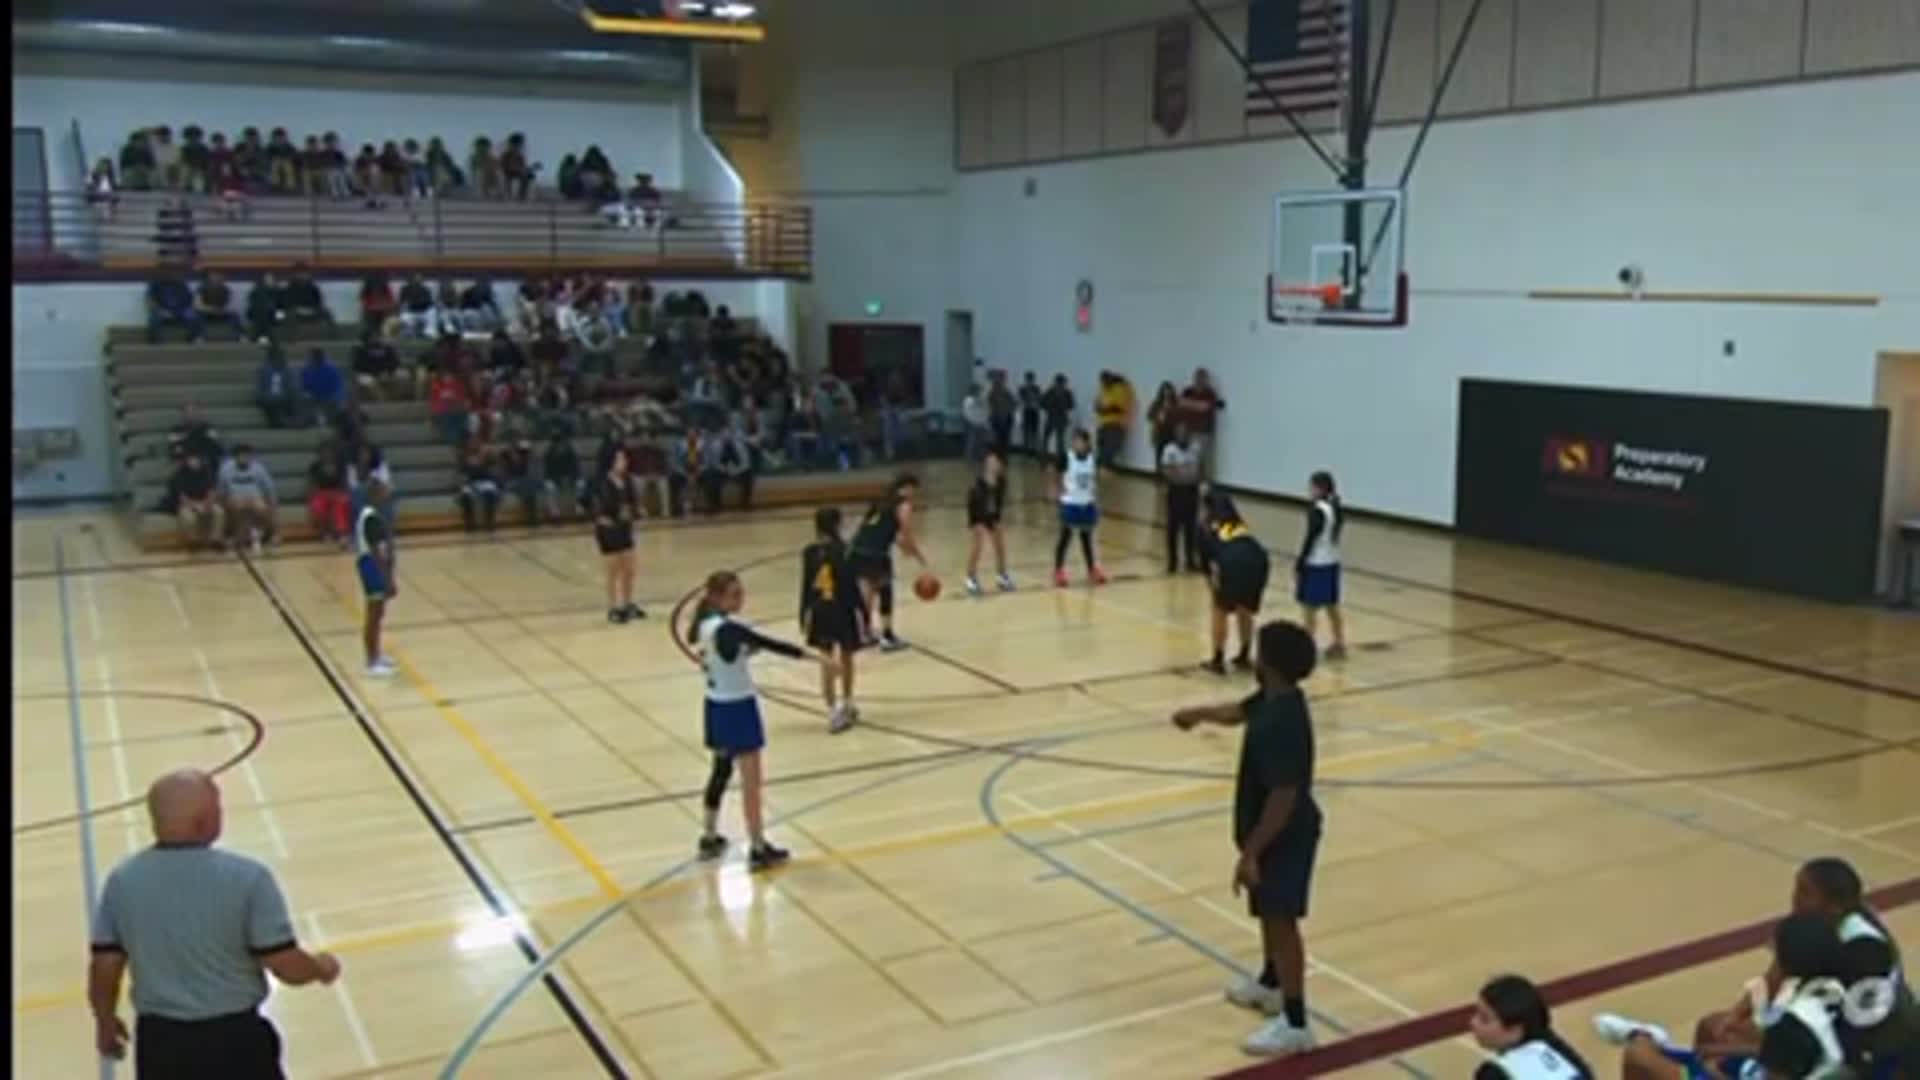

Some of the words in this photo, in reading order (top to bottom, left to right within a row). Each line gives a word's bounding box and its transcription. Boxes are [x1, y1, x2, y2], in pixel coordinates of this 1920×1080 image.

[1613, 442, 1706, 473] Preparatory
[1613, 464, 1684, 491] Academy
[814, 562, 834, 601] 4
